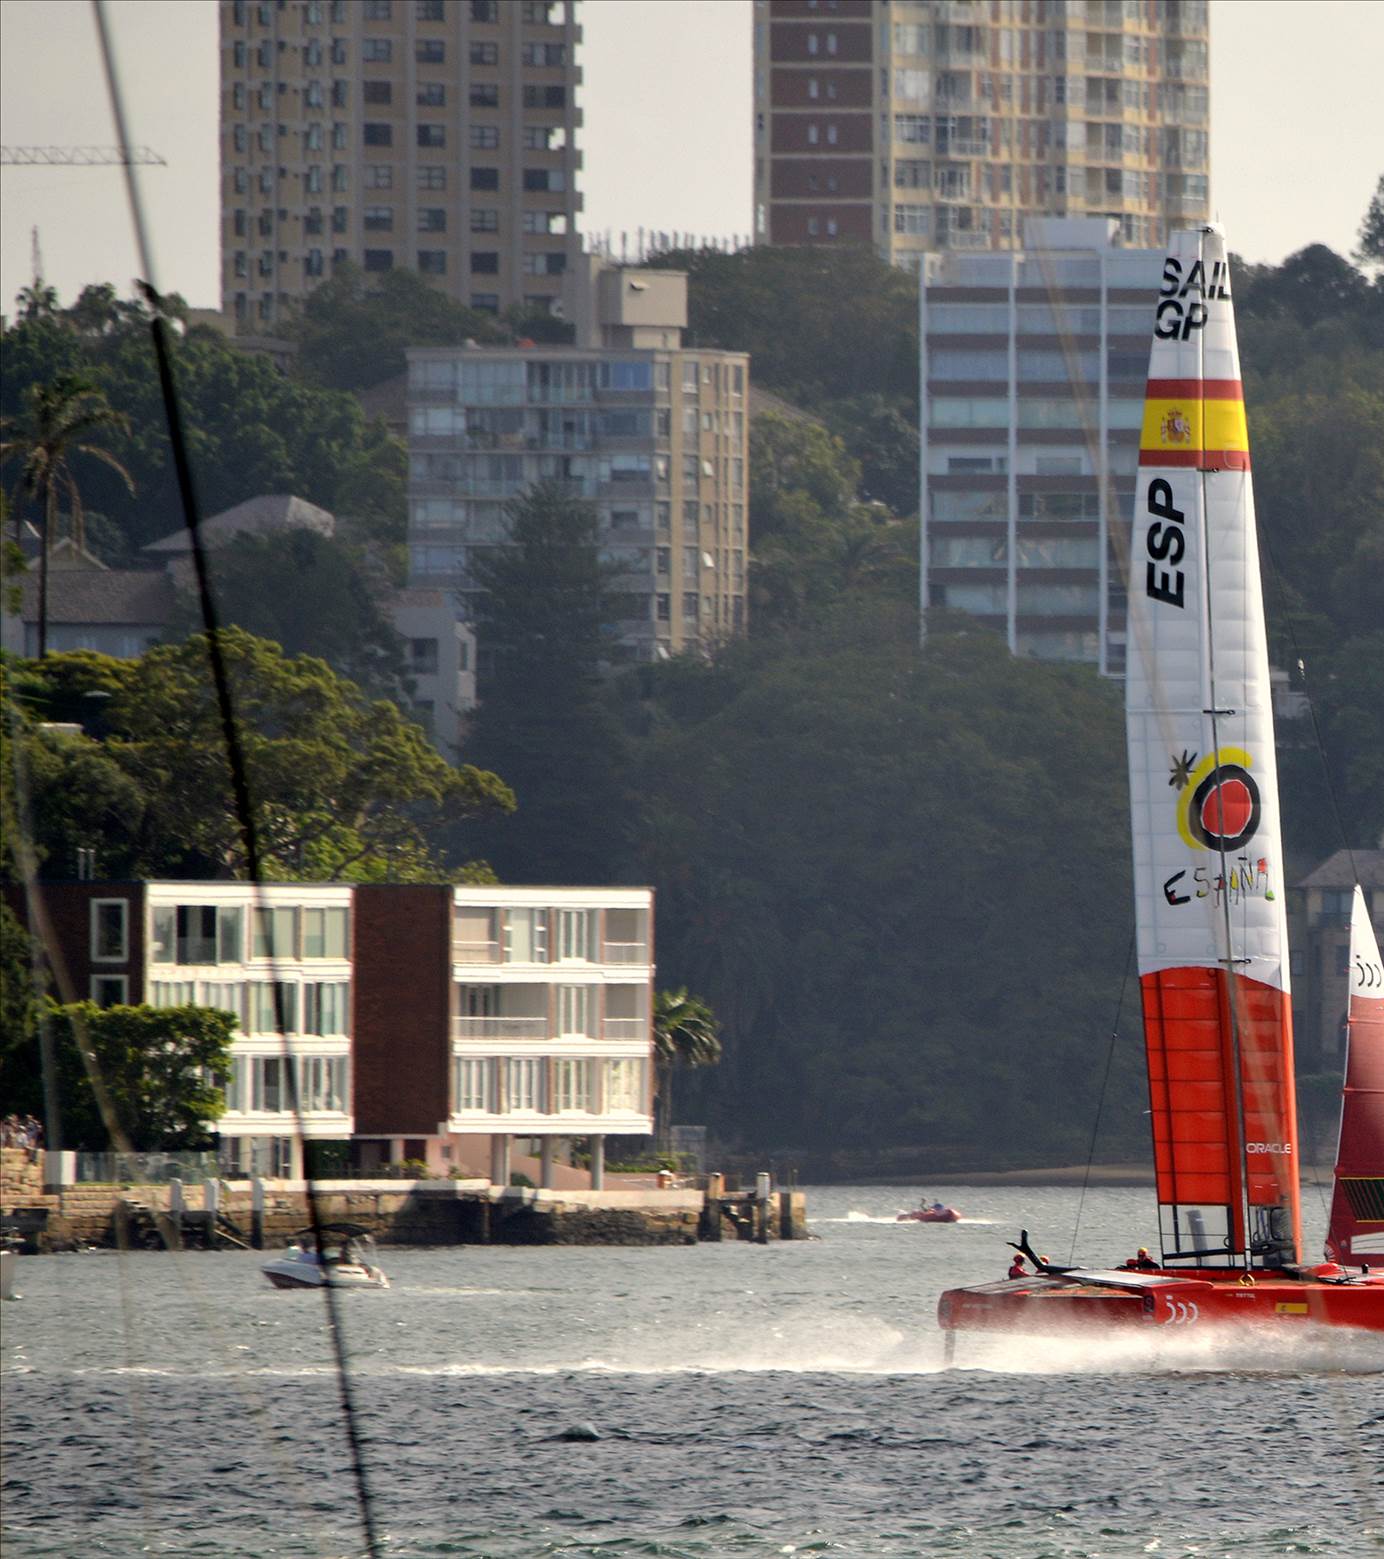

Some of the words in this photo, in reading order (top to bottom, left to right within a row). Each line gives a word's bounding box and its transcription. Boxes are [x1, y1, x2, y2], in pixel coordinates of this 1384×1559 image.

[1160, 257, 1231, 299] SAIL
[1154, 299, 1208, 341] GP
[1147, 477, 1185, 609] ESP
[1246, 1143, 1292, 1154] ORACLE
